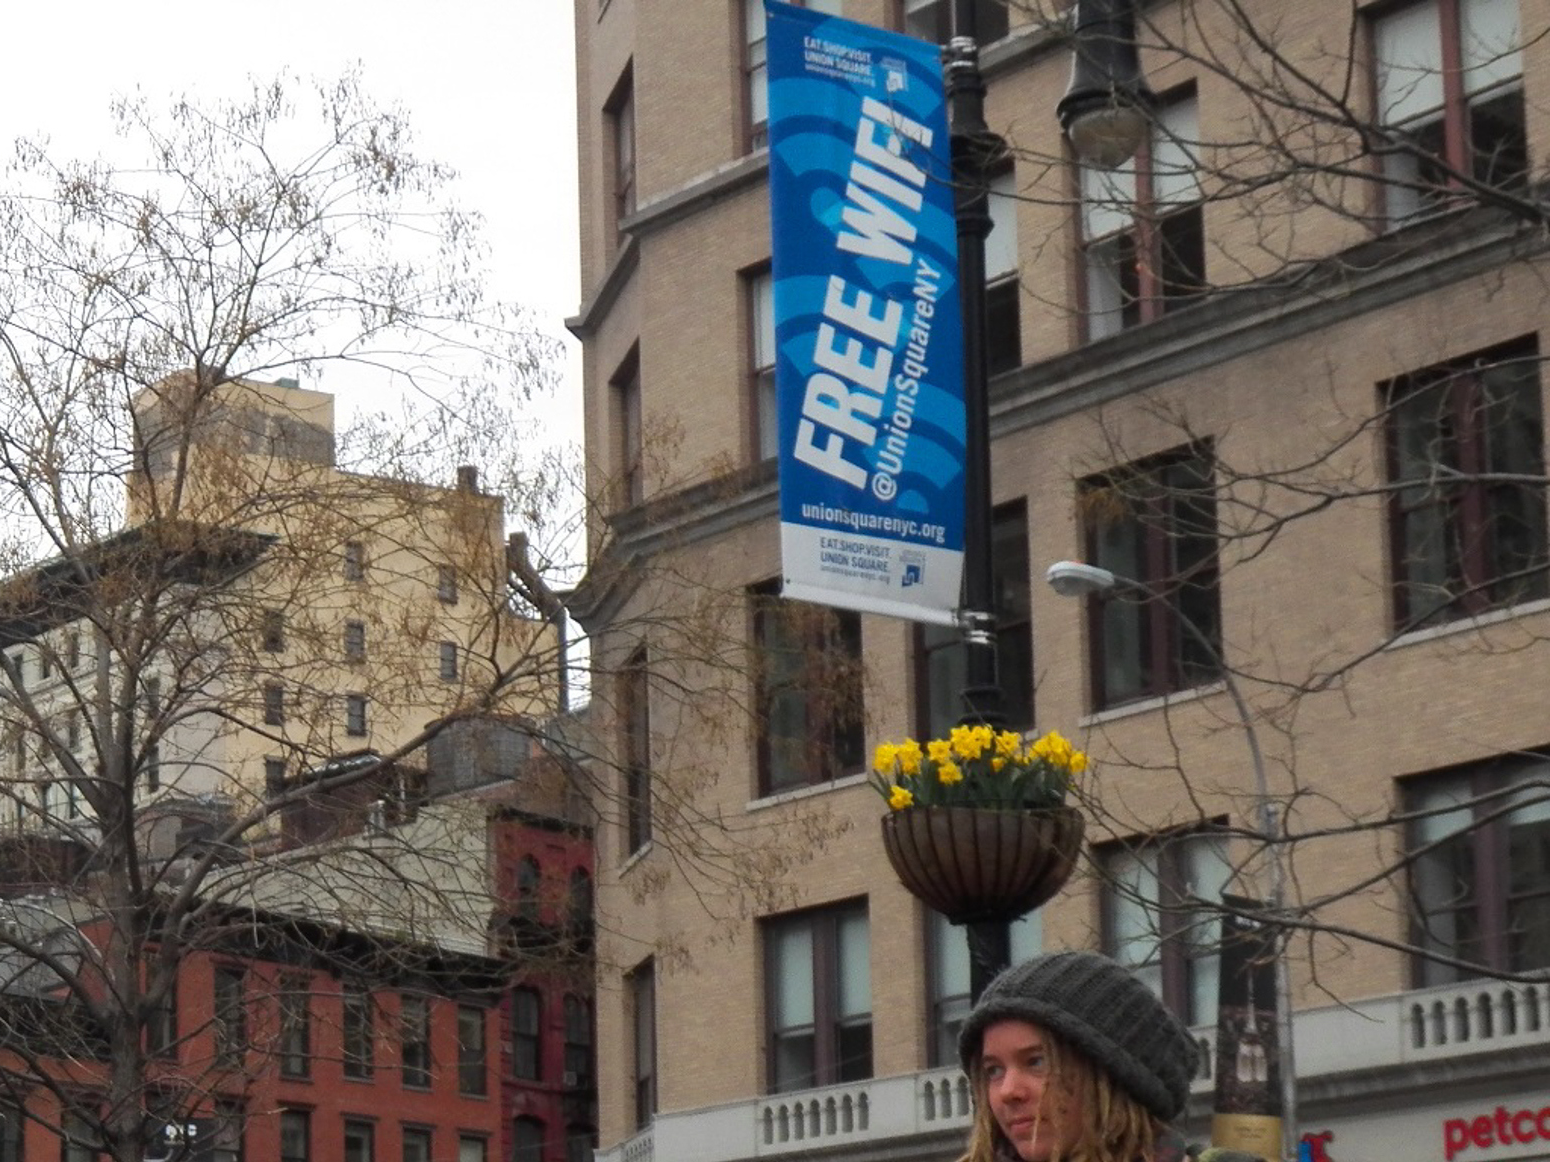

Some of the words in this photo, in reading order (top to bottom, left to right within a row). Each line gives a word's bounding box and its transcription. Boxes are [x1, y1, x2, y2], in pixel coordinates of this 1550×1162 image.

[836, 95, 934, 266] WIFI
[793, 274, 904, 490] FREE
[871, 257, 941, 501] @UnionSquareNY
[801, 502, 946, 543] unionsquarenyc.org
[820, 551, 849, 566] UNION
